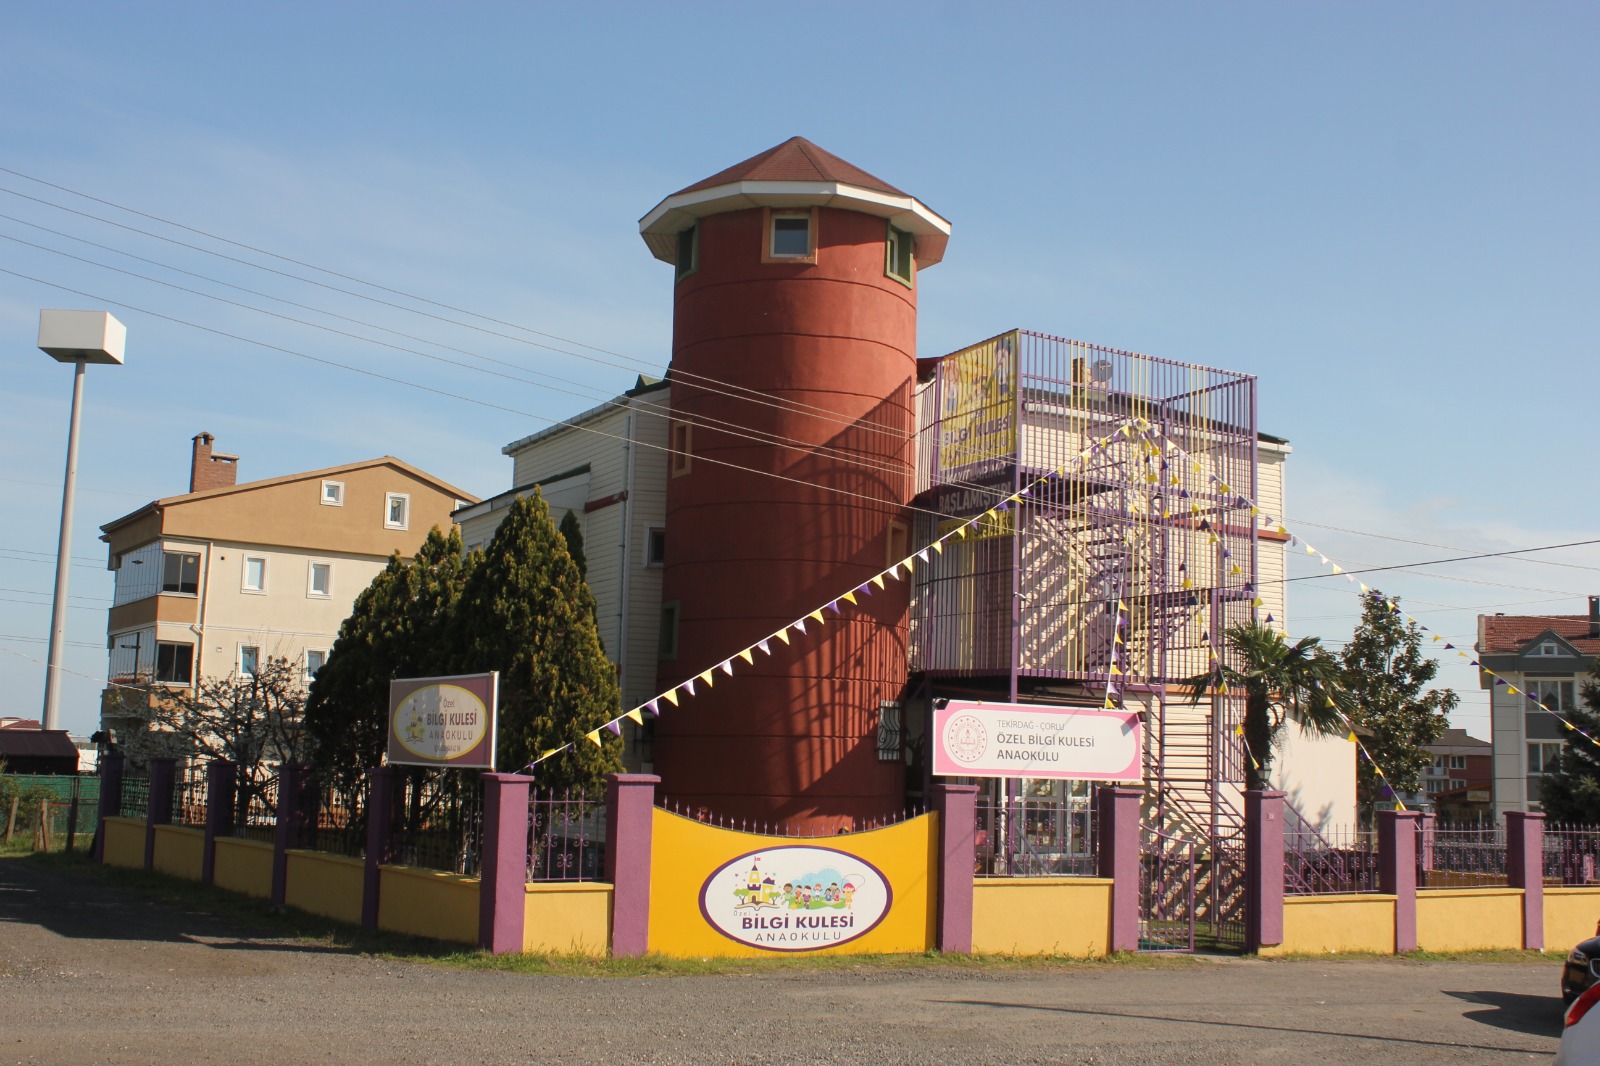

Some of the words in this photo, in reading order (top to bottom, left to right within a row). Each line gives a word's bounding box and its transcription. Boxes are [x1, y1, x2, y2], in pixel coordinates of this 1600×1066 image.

[427, 709, 447, 726] BİLGİ
[449, 708, 477, 726] KULESİ
[997, 719, 1034, 730] TEKİRDAĞ
[1040, 721, 1065, 731] ÇORLU
[430, 730, 473, 740] ANAOKULU
[996, 731, 1026, 745] ÖZEL
[1028, 733, 1056, 746] BİLGİ
[1058, 736, 1095, 748] KULESİ
[997, 749, 1059, 762] ANAOKULU
[742, 913, 789, 930] BİLGİ
[795, 912, 854, 929] KULESİ
[755, 931, 842, 942] ANAOKULU
